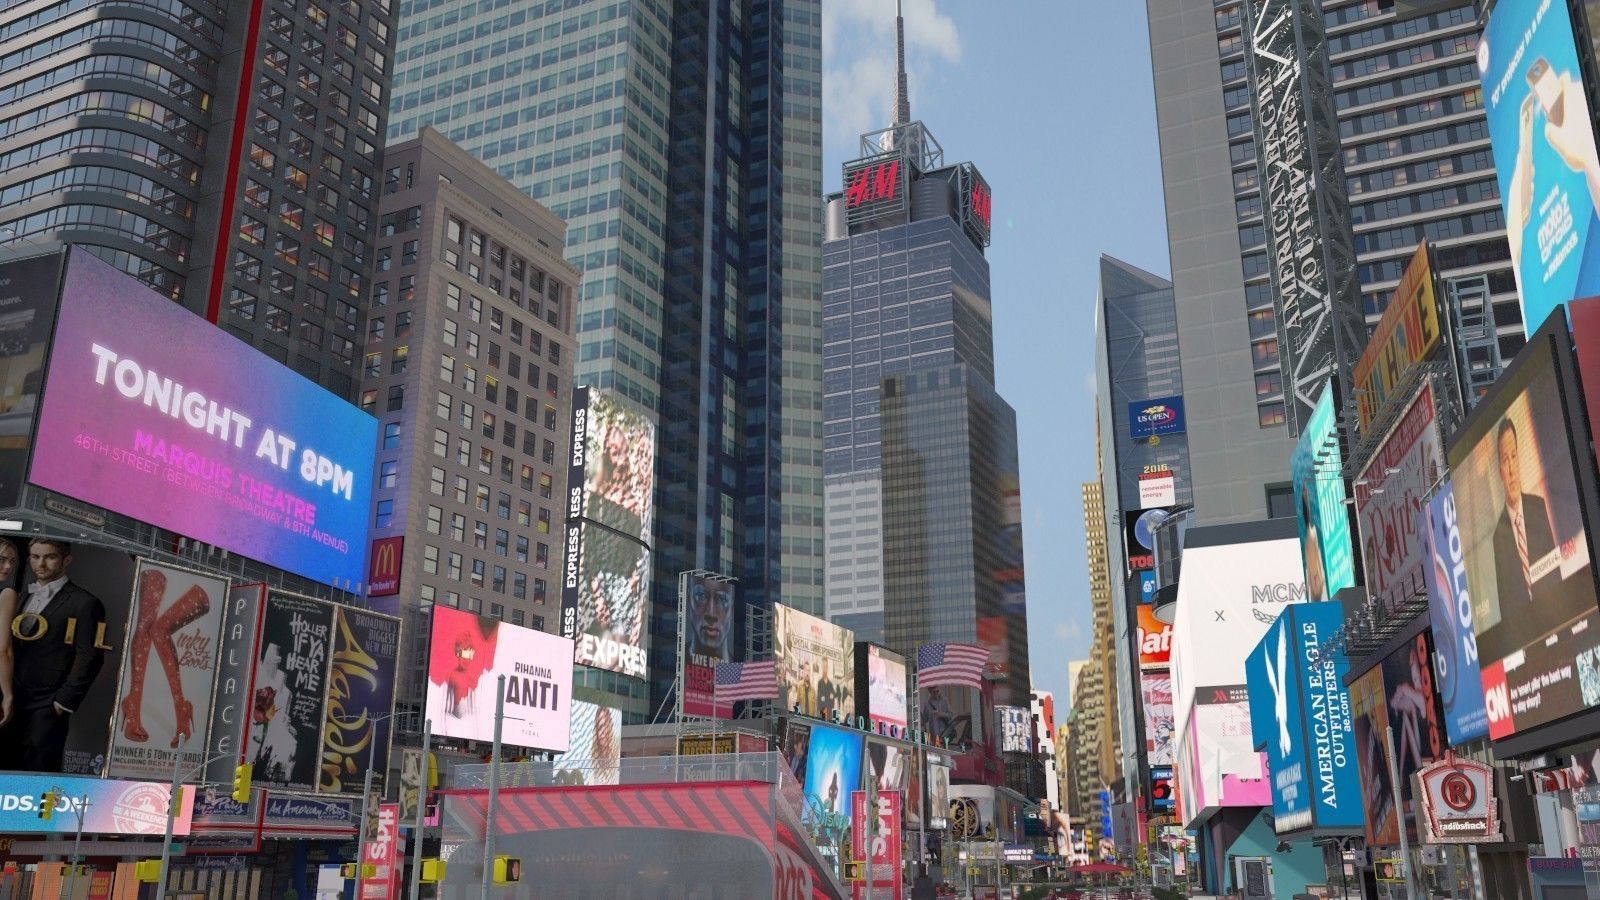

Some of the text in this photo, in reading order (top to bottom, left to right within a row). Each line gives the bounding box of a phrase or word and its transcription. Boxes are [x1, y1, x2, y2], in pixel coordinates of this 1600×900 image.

[1257, 68, 1302, 328] AMERICAN EAGLE
[92, 342, 354, 500] TONIGHT AT 8PM
[1138, 412, 1170, 423] US OPEN
[573, 408, 586, 467] EXPRESS
[133, 429, 317, 526] MARQUIS THEATRE
[1143, 463, 1168, 474] 2016
[74, 433, 109, 456] 46TH
[111, 447, 160, 475] STREET
[311, 528, 349, 555] AVENUE)
[1141, 483, 1173, 493] renewable
[1142, 491, 1163, 499] energy
[566, 527, 580, 589] EXPRESS
[1443, 491, 1478, 667] SOLO 2
[1251, 582, 1307, 604] MCM
[289, 611, 328, 640] HOLLER
[368, 629, 396, 645] BIGGEST
[293, 634, 325, 662] IF YA
[692, 654, 708, 667] TAYE
[218, 598, 248, 754] PALACE
[286, 652, 320, 676] HEAR
[514, 661, 553, 679] RIHANNA
[294, 670, 320, 692] ME
[505, 675, 559, 711] ANTI
[1303, 622, 1338, 808] AMERICAN EAGLE
[1324, 660, 1347, 768] OUTFITTERS
[1339, 692, 1351, 732] ae.com
[521, 728, 540, 737] TIDAL
[869, 717, 950, 750] BROADWAY
[114, 746, 147, 760] WINNER!
[154, 749, 172, 761] TONY
[268, 800, 281, 814] An
[282, 799, 323, 819] American
[1439, 820, 1487, 832] radioshack
[1536, 861, 1560, 869] BLUE
[1562, 861, 1577, 869] FIN
